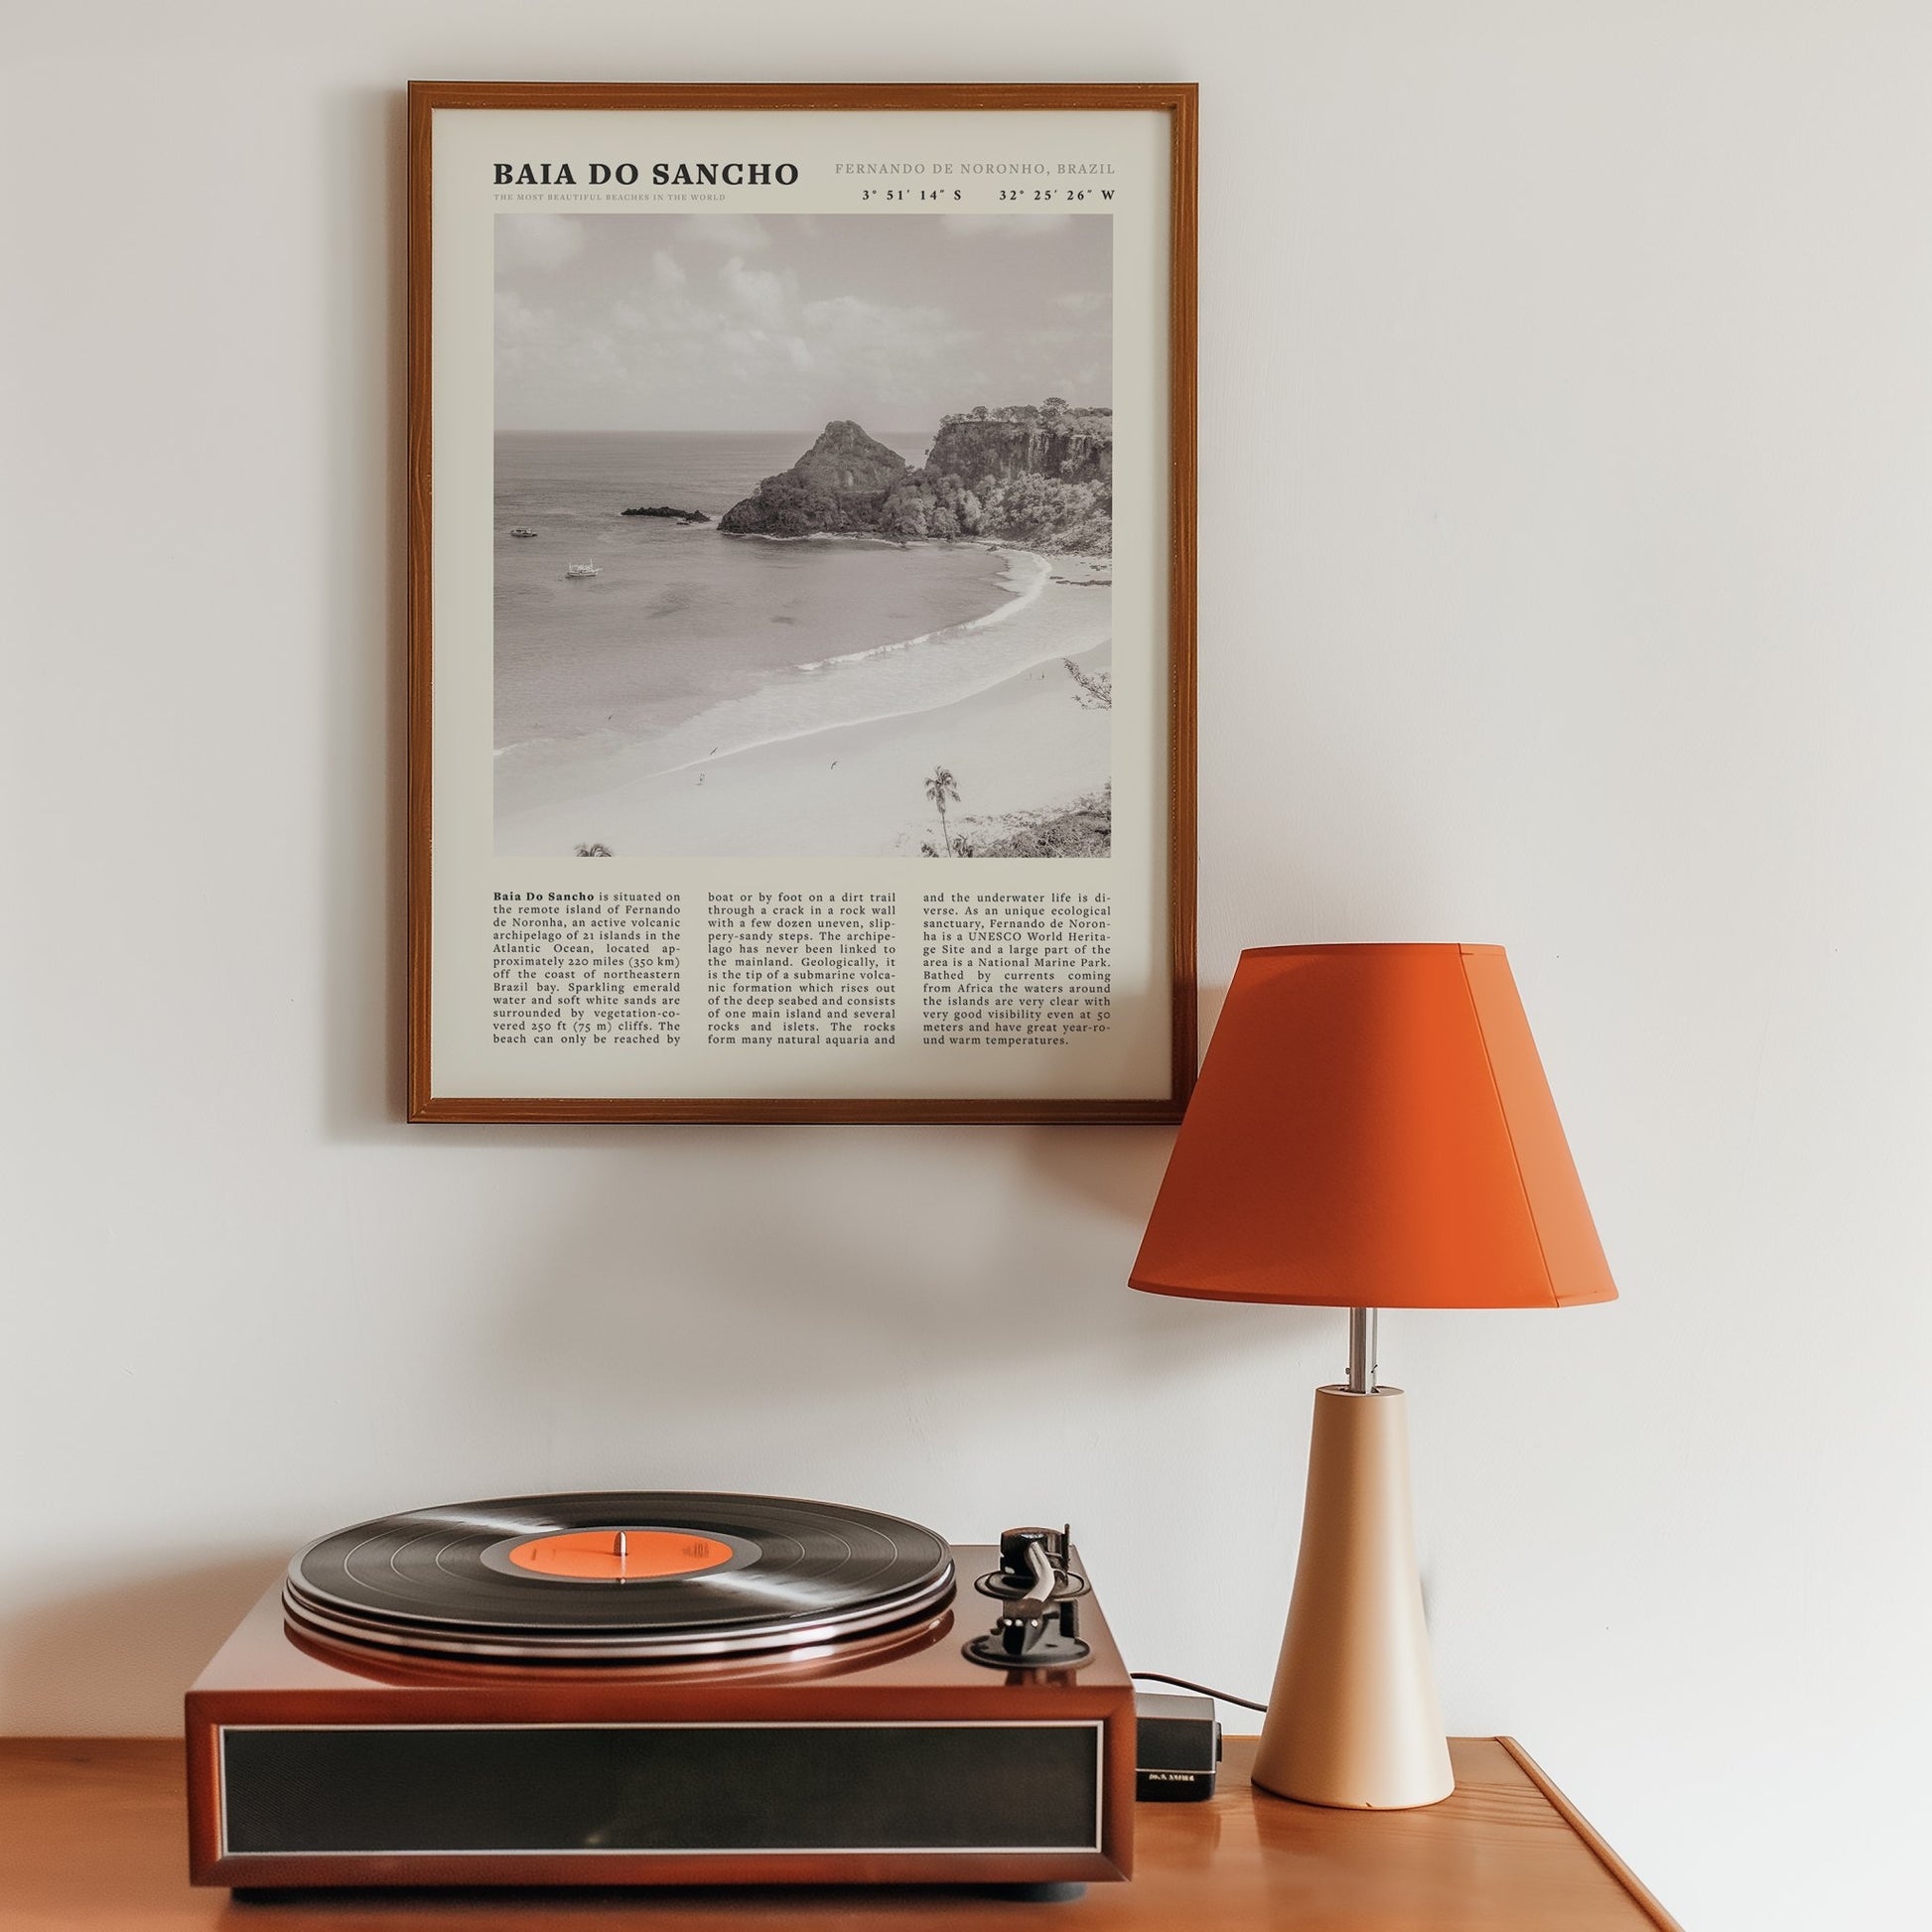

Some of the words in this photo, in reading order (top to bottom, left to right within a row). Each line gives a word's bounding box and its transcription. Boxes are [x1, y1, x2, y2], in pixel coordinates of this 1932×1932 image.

[492, 163, 578, 186] BAIA
[588, 162, 639, 186] DO
[651, 163, 799, 186] SANCHO
[835, 163, 925, 175] FERNANDO
[932, 163, 953, 175] DE
[960, 163, 1050, 177] NORONHO,
[1057, 163, 1115, 175] BRAZIL
[953, 189, 962, 202] S
[1100, 190, 1116, 201] W
[492, 891, 522, 901] Baia
[525, 892, 544, 901] Do
[547, 891, 595, 902] Sancho
[599, 892, 610, 902] is
[613, 891, 662, 902] situated
[665, 894, 681, 902] on
[922, 892, 945, 902] and
[950, 892, 971, 902] the
[976, 892, 1045, 903] underwater
[1050, 892, 1071, 903] life
[1078, 893, 1088, 903] is
[1094, 892, 1111, 903] di-
[492, 903, 512, 914] the
[517, 905, 560, 914] remote
[565, 903, 602, 914] island
[607, 903, 621, 914] of
[624, 903, 681, 915] Fernando
[922, 907, 959, 916] verse.
[964, 905, 979, 915] As
[984, 907, 999, 916] an
[1004, 905, 1045, 918] unique
[1050, 905, 1111, 919] ecological
[492, 916, 507, 927] de
[511, 916, 568, 929] Noronha,
[590, 917, 626, 928] active
[630, 916, 681, 928] volcanic
[707, 917, 735, 928] with
[739, 919, 746, 928] a
[751, 917, 772, 928] few
[776, 917, 812, 928] dozen
[817, 919, 864, 930] uneven,
[869, 917, 896, 931] slip-
[922, 919, 985, 931] sanctuary,
[989, 917, 1045, 929] Fernando
[1049, 917, 1064, 929] de
[1068, 916, 1111, 929] Noron-
[708, 930, 773, 944] pery-sandy
[778, 932, 813, 944] steps.
[818, 930, 841, 941] The
[846, 930, 896, 944] archipe-
[492, 942, 541, 953] Atlantic
[553, 943, 595, 955] Ocean,
[606, 942, 650, 954] located
[661, 945, 681, 957] ap-
[708, 943, 733, 957] lago
[739, 943, 759, 954] has
[765, 945, 799, 954] never
[804, 943, 833, 954] been
[840, 943, 877, 954] linked
[883, 945, 897, 954] to
[492, 955, 565, 969] proximately
[592, 955, 624, 967] miles
[628, 956, 654, 969] (350
[656, 954, 680, 969] km)
[707, 956, 728, 967] the
[735, 956, 793, 967] mainland.
[800, 956, 879, 970] Geologically,
[886, 956, 897, 967] it
[923, 969, 964, 981] Bathed
[977, 969, 991, 984] by
[1004, 972, 1055, 981] currents
[1067, 970, 1111, 984] coming
[493, 981, 528, 992] Brazil
[536, 981, 560, 995] bay.
[568, 981, 625, 996] Sparkling
[632, 981, 681, 993] emerald
[708, 982, 726, 993] nic
[733, 982, 792, 993] formation
[798, 982, 834, 993] which
[841, 983, 870, 994] rises
[876, 984, 896, 994] out
[922, 982, 951, 994] from
[957, 982, 994, 994] Africa
[999, 983, 1019, 994] the
[1024, 985, 1063, 994] waters
[1068, 982, 1111, 994] around
[492, 996, 526, 1005] water
[531, 994, 553, 1005] and
[557, 994, 581, 1006] soft
[585, 994, 619, 1006] white
[623, 994, 657, 1006] sands
[661, 997, 681, 1006] are
[922, 995, 942, 1007] the
[947, 996, 990, 1007] islands
[995, 998, 1014, 1007] are
[1019, 998, 1044, 1010] very
[1049, 996, 1079, 1007] clear
[1084, 996, 1111, 1007] with
[492, 1007, 561, 1019] surrounded
[570, 1007, 585, 1022] by
[593, 1008, 680, 1021] vegetation-co-
[707, 1008, 721, 1019] of
[725, 1010, 747, 1019] one
[752, 1009, 780, 1019] main
[785, 1008, 822, 1019] island
[826, 1008, 849, 1019] and
[853, 1008, 896, 1020] several
[922, 1011, 949, 1022] very
[953, 1009, 983, 1022] good
[987, 1009, 1041, 1023] visibility
[1046, 1011, 1074, 1020] even
[1079, 1011, 1091, 1020] at
[1097, 1011, 1111, 1022] 50
[707, 1021, 740, 1032] rocks
[750, 1021, 772, 1032] and
[782, 1021, 819, 1033] islets.
[830, 1021, 853, 1033] The
[863, 1021, 896, 1033] rocks
[922, 1024, 964, 1033] meters
[968, 1022, 990, 1033] and
[995, 1022, 1023, 1033] have
[1026, 1024, 1057, 1035] great
[1062, 1024, 1111, 1035] year-ro-
[492, 1033, 527, 1044] beach
[533, 1035, 554, 1044] can
[560, 1034, 587, 1046] only
[593, 1034, 607, 1044] be
[614, 1034, 660, 1044] reached
[666, 1034, 681, 1047] by
[707, 1034, 737, 1044] form
[741, 1036, 773, 1047] many
[777, 1034, 821, 1044] natural
[825, 1035, 870, 1047] aquaria
[874, 1035, 896, 1045] and
[922, 1034, 945, 1045] und
[948, 1036, 981, 1045] warm
[985, 1036, 1069, 1048] temperatures.
